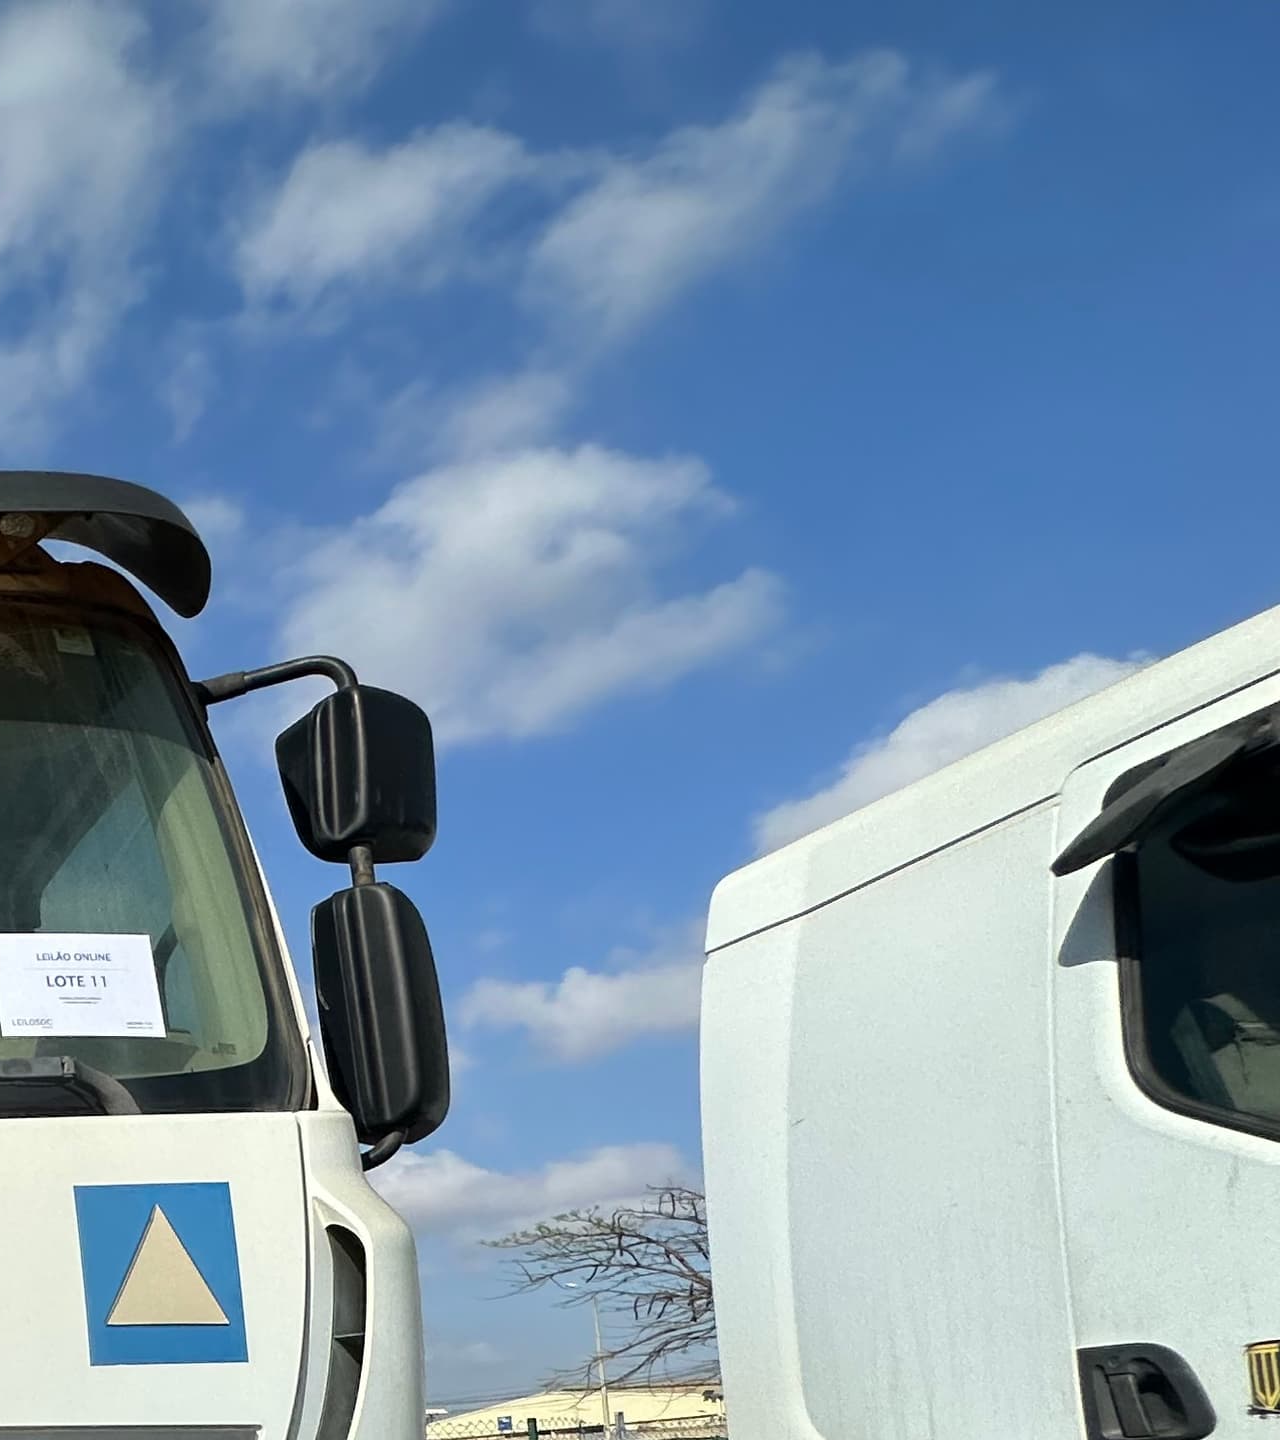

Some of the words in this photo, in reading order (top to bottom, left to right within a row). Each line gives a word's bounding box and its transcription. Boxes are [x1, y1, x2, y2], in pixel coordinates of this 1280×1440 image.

[36, 951, 71, 962] LEILÃO
[73, 952, 112, 962] ONLINE
[46, 975, 86, 988] LOTE
[90, 975, 107, 988] 11
